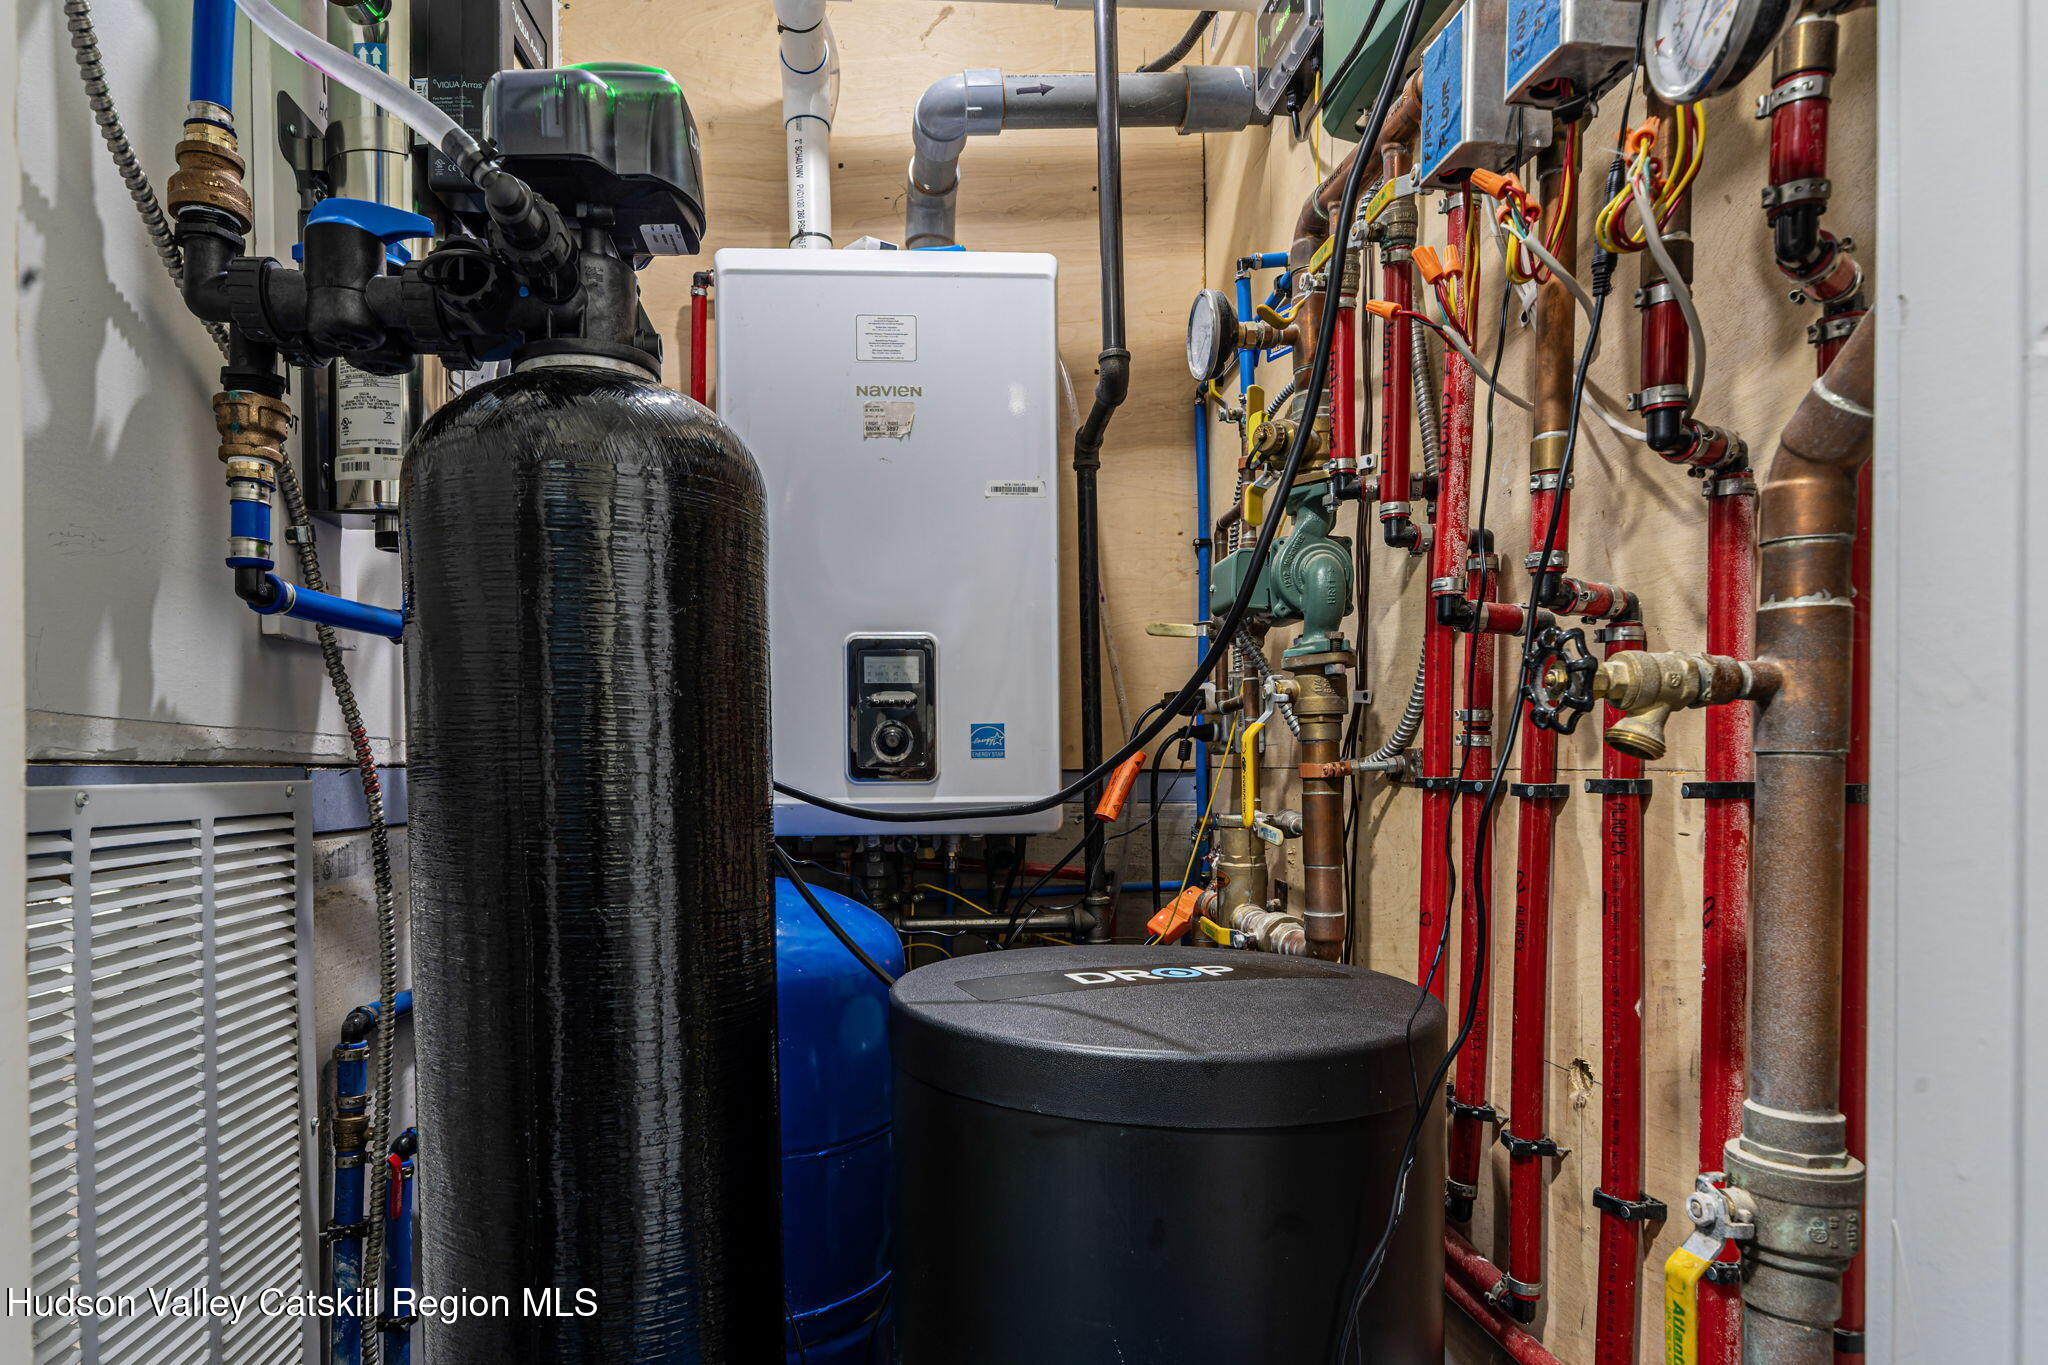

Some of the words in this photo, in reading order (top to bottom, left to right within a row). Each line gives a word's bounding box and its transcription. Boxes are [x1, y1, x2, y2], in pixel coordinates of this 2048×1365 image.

[437, 79, 461, 89] VIQUA
[461, 79, 483, 89] Arros
[1610, 802, 1627, 857] ALROPEX
[1065, 963, 1235, 987] DROP
